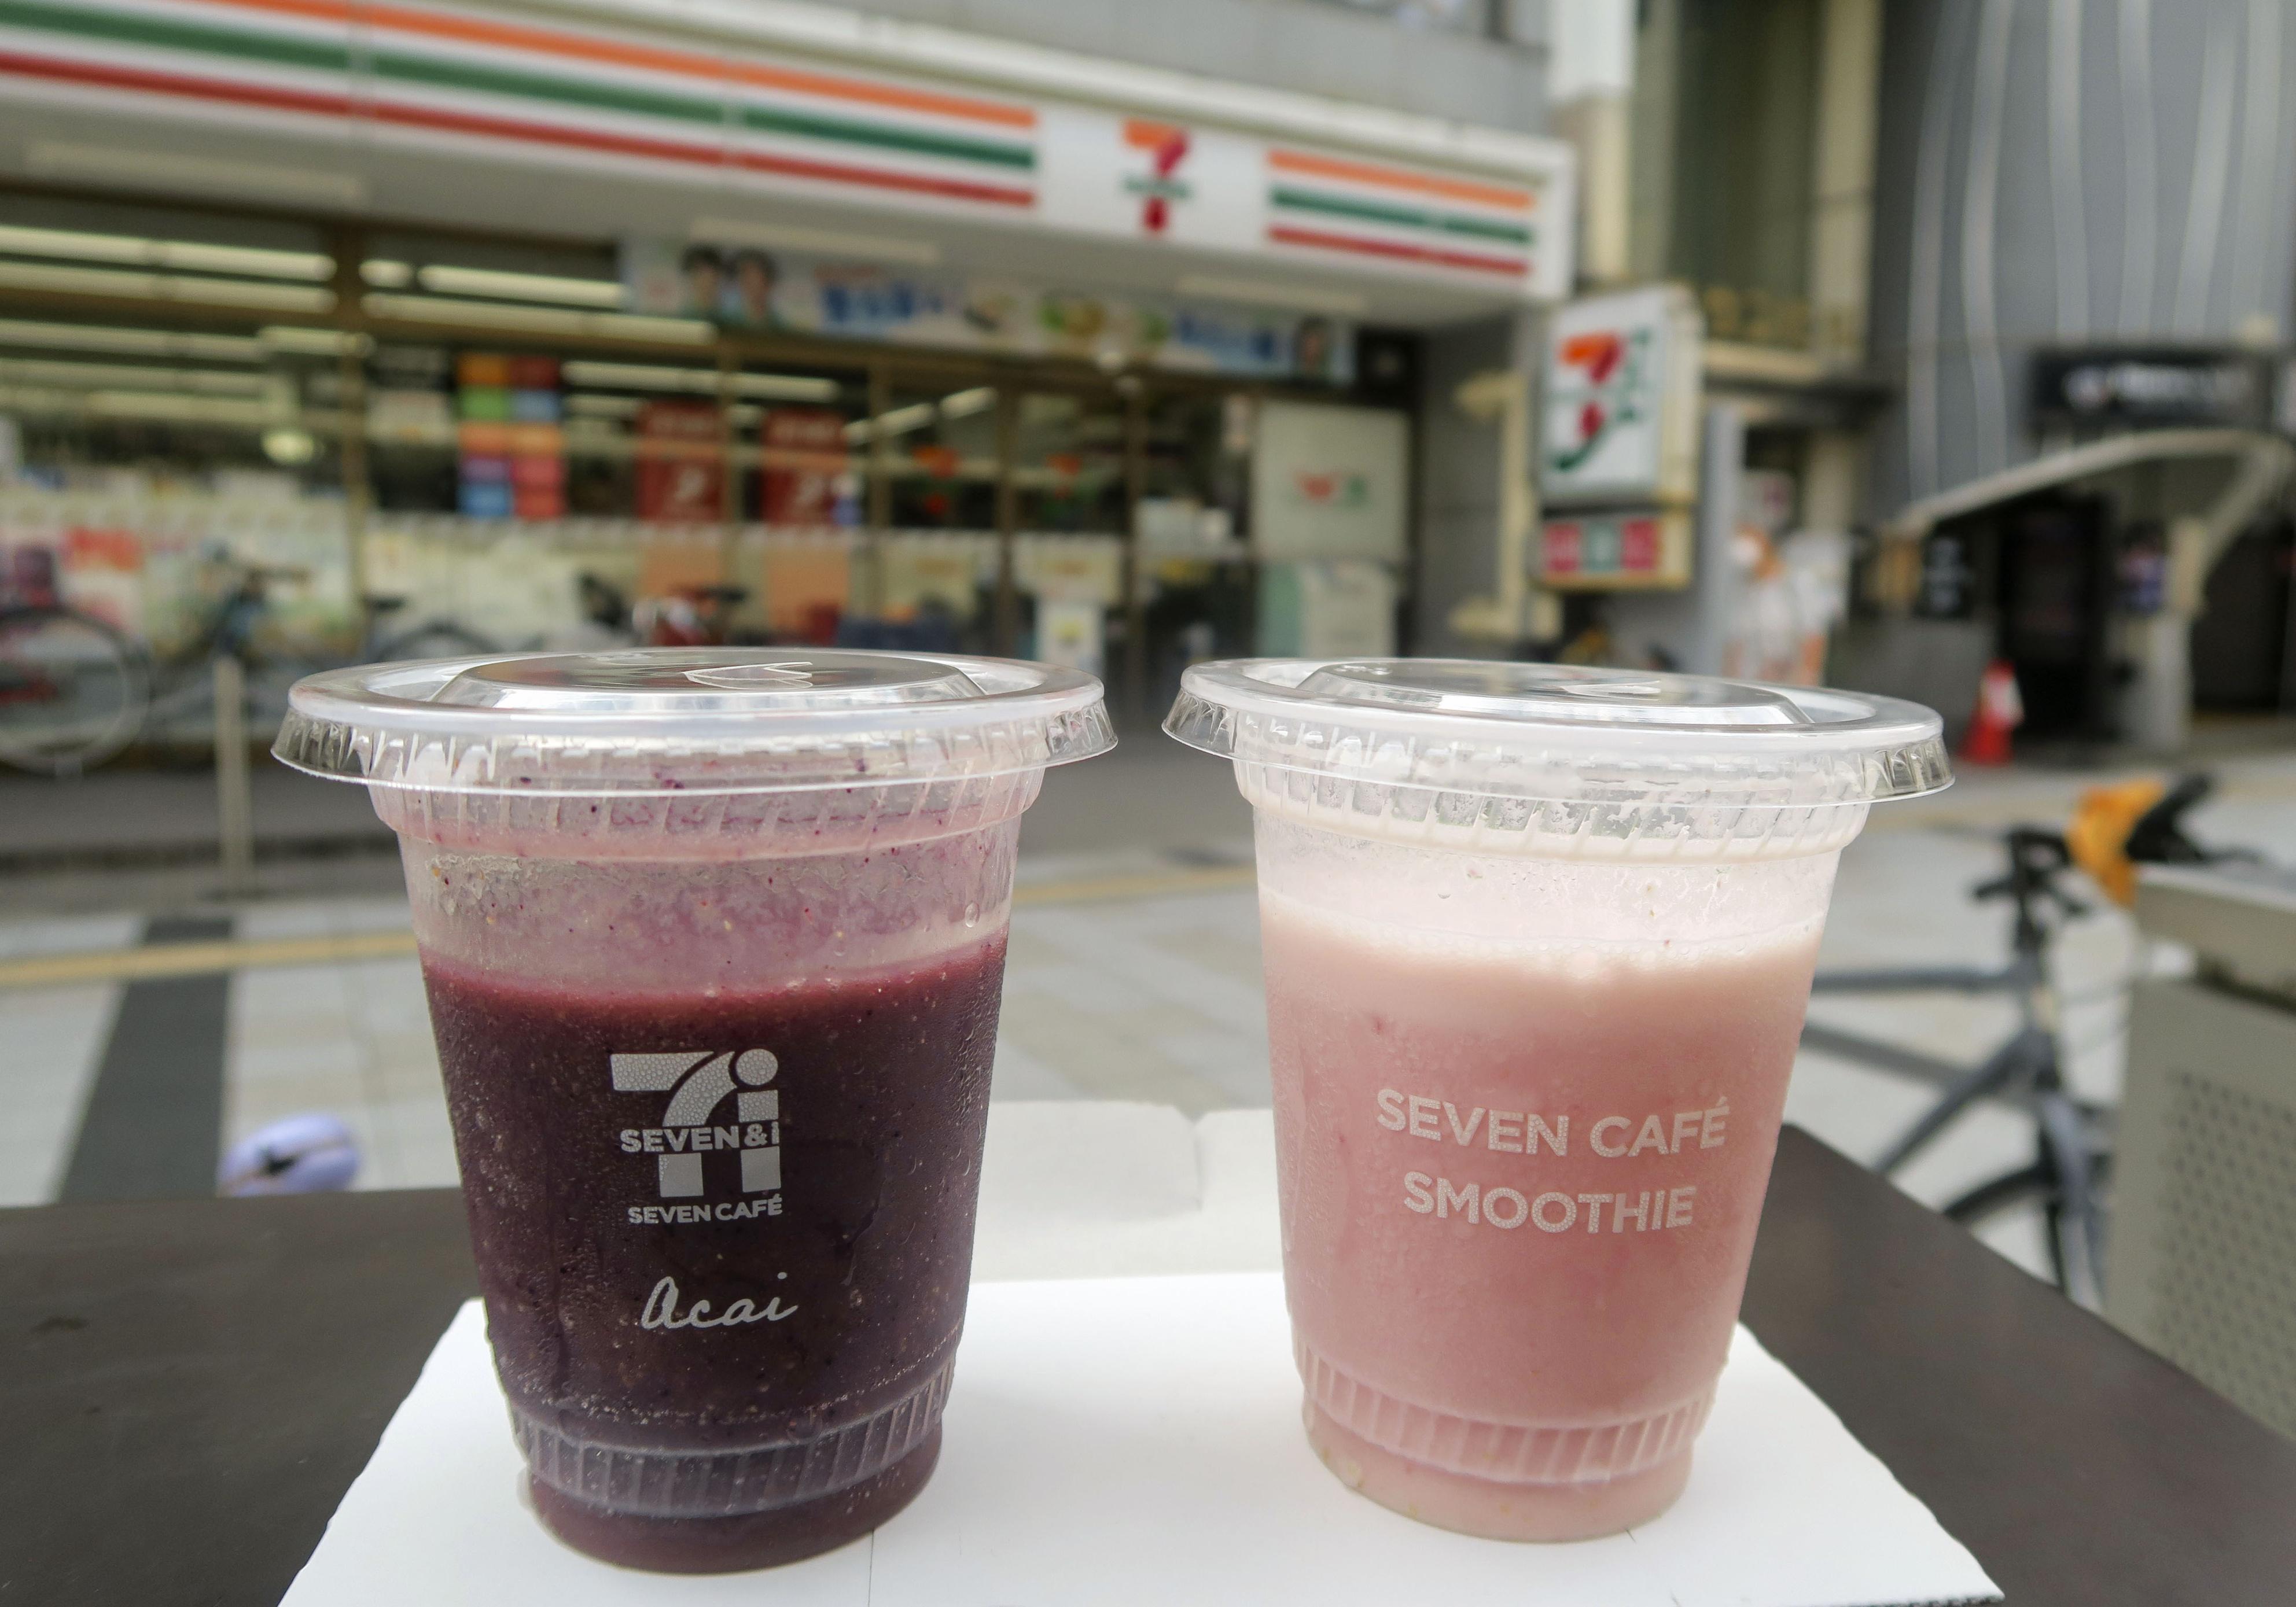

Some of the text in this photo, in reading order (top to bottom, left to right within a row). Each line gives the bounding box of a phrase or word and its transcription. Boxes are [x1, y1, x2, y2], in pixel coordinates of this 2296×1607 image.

[1376, 1088, 1731, 1158] SEVEN CAFÉ
[627, 1193, 783, 1225] SEVEN CAFÉ
[1403, 1170, 1698, 1234] SMOOTHIE
[640, 1271, 799, 1330] Acai
